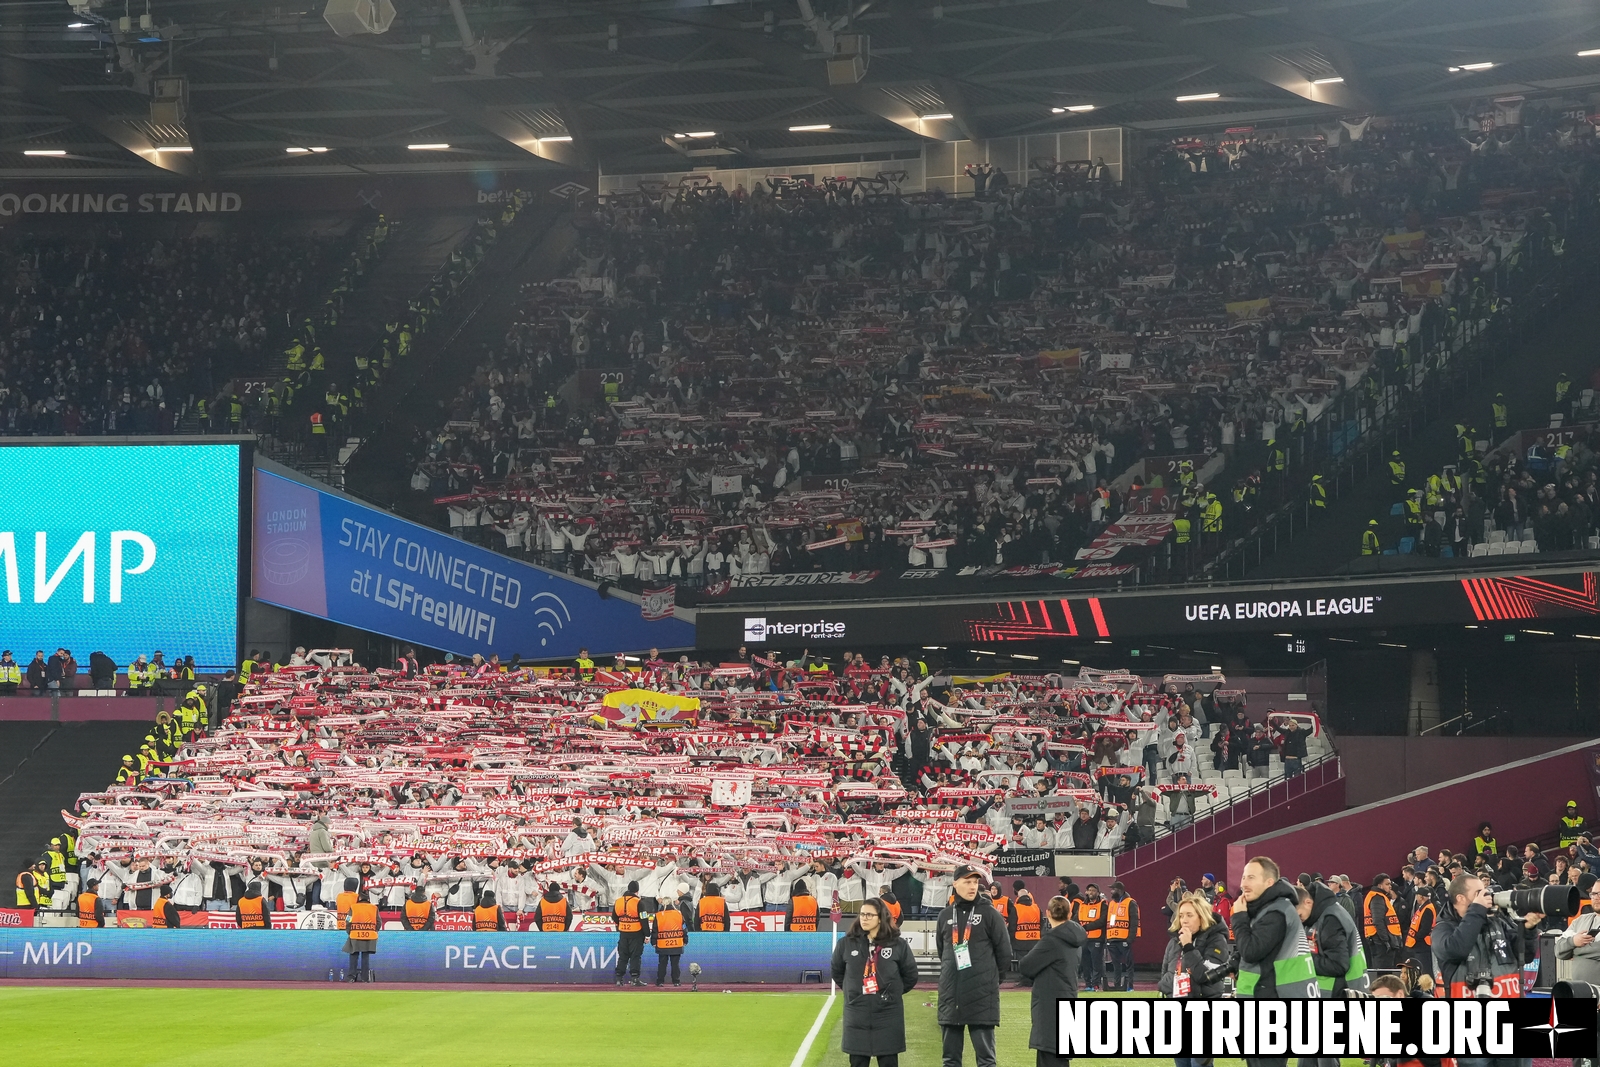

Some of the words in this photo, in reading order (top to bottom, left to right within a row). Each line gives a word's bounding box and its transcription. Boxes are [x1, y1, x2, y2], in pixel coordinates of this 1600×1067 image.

[138, 193, 242, 213] STAND
[267, 508, 308, 523] LONDON
[267, 520, 308, 534] STADIUM
[0, 531, 156, 604] ИР
[338, 517, 390, 558] STAY
[394, 538, 521, 609] CONNECTED
[349, 568, 372, 598] at
[374, 580, 497, 646] LSFreeWIFI
[1185, 605, 1231, 622] UEFA
[1235, 600, 1302, 620] EUROPA
[1306, 596, 1374, 616] LEAGUE
[810, 632, 846, 640] rent-a-car
[629, 799, 673, 807] FREIBURG
[895, 810, 954, 818] SPORT-CLUB
[535, 855, 586, 871] CORRILL
[588, 855, 655, 867] CORRILLO
[357, 931, 370, 939] 130
[658, 931, 683, 939] STEWARD
[22, 941, 93, 965] МИР
[445, 945, 538, 969] PEACE
[1462, 976, 1520, 998] POTO
